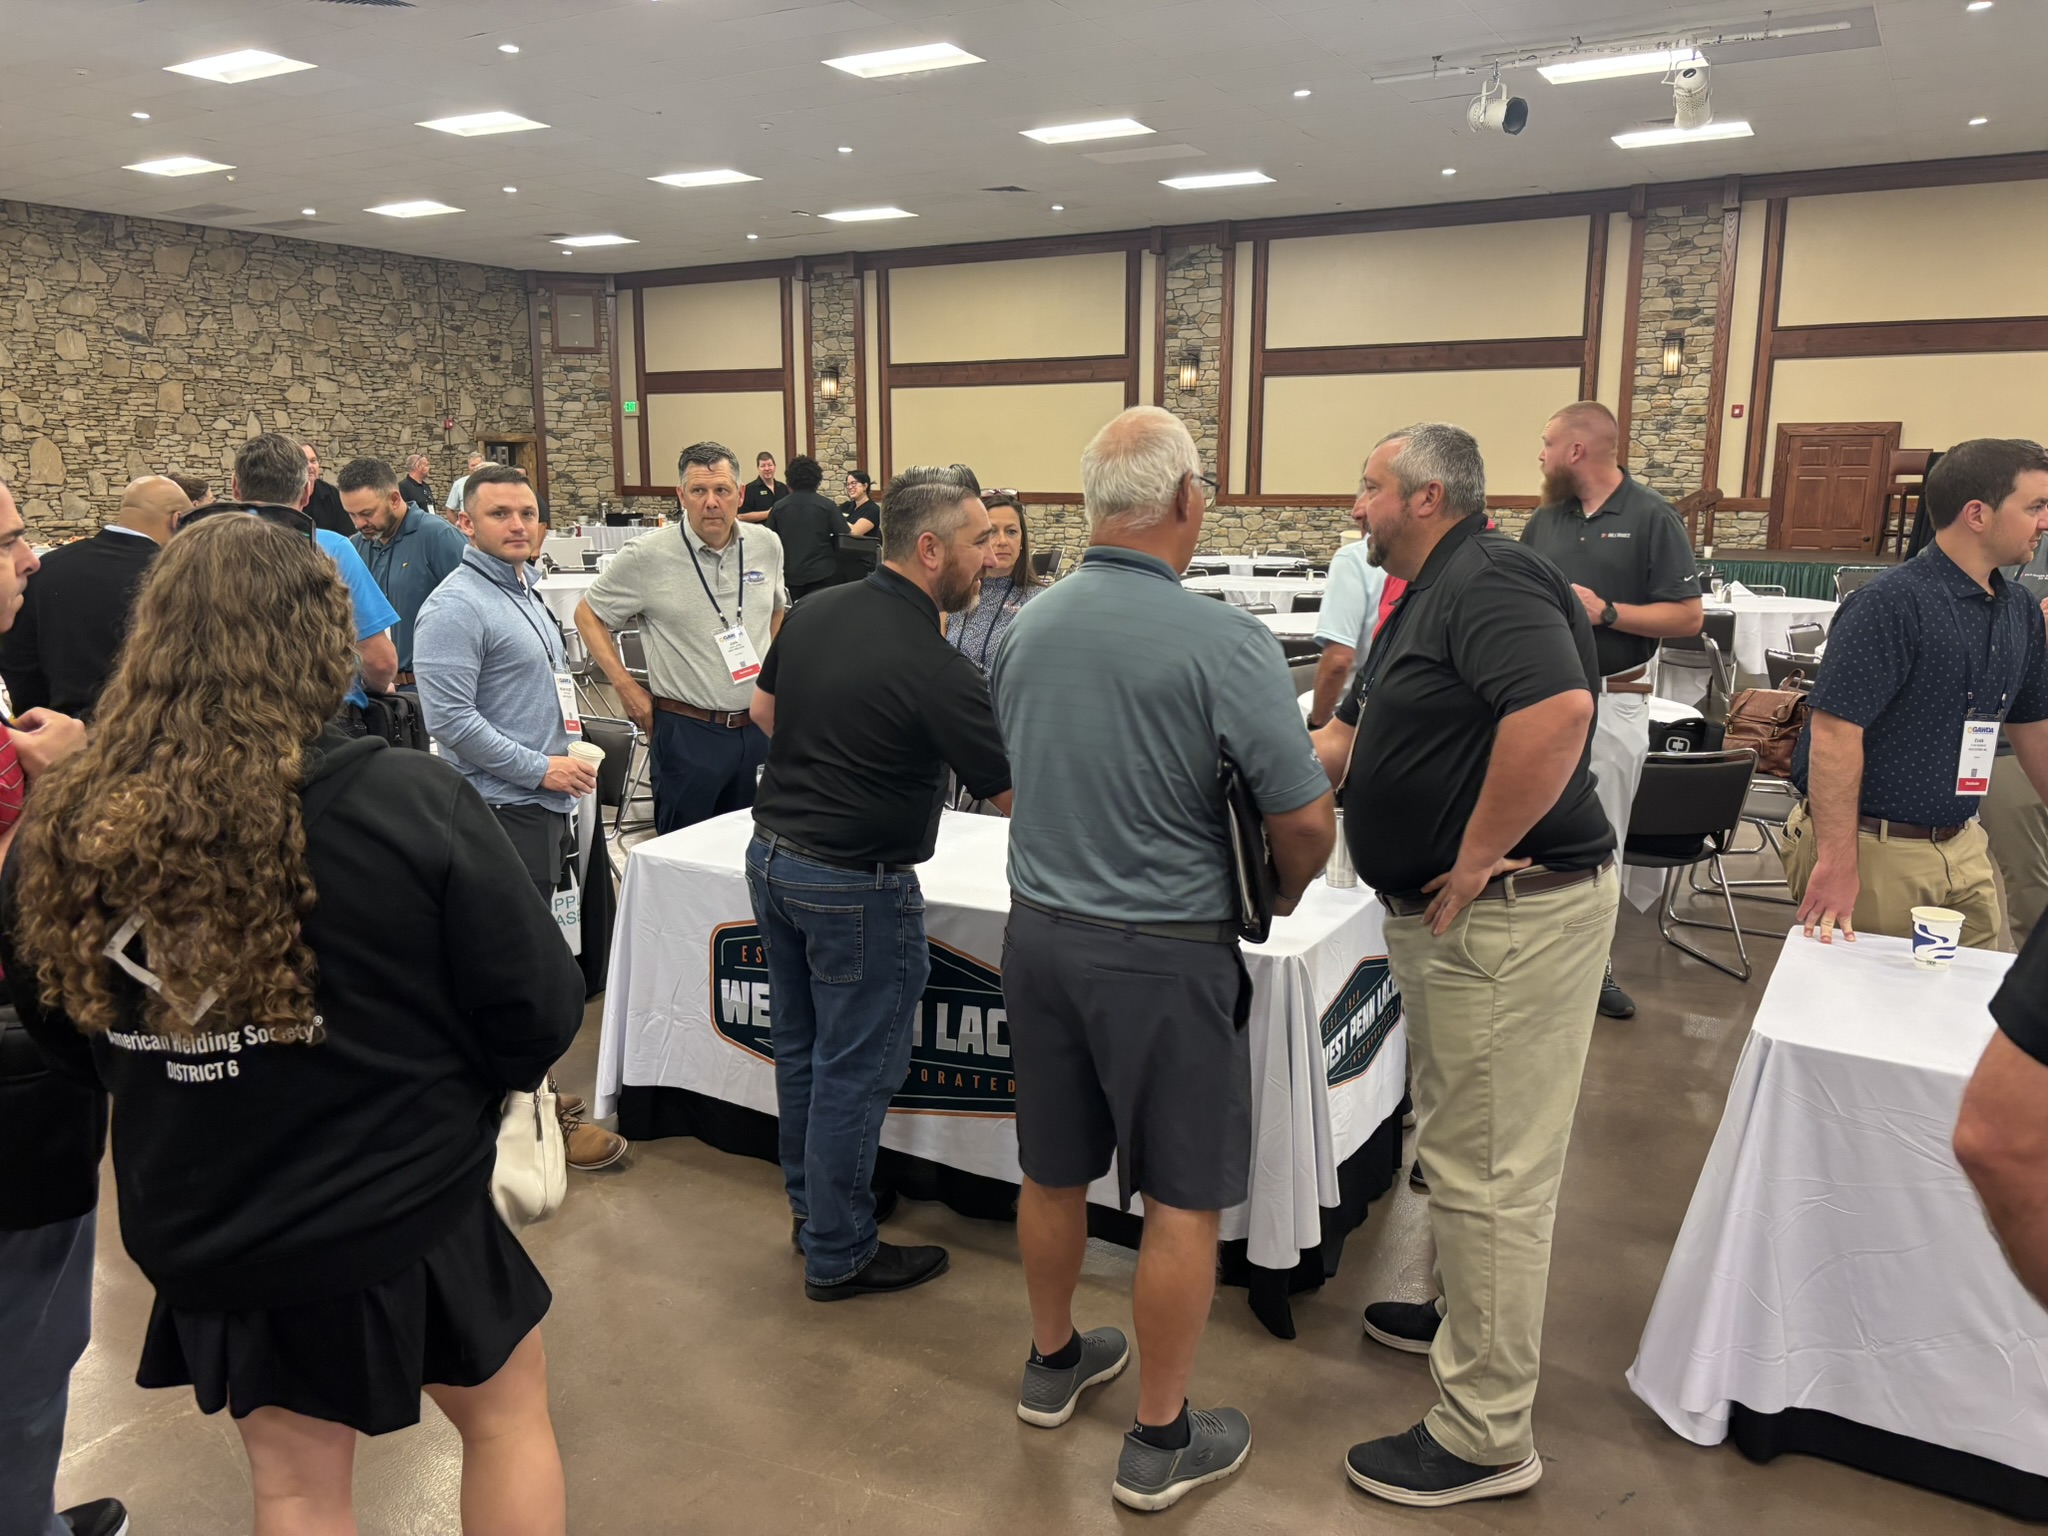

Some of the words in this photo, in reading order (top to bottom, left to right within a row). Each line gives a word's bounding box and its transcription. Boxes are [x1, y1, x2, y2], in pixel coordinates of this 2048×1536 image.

[1349, 994, 1376, 1049] PENN
[166, 1061, 224, 1083] DISTRICT
[227, 1059, 240, 1078] 6
